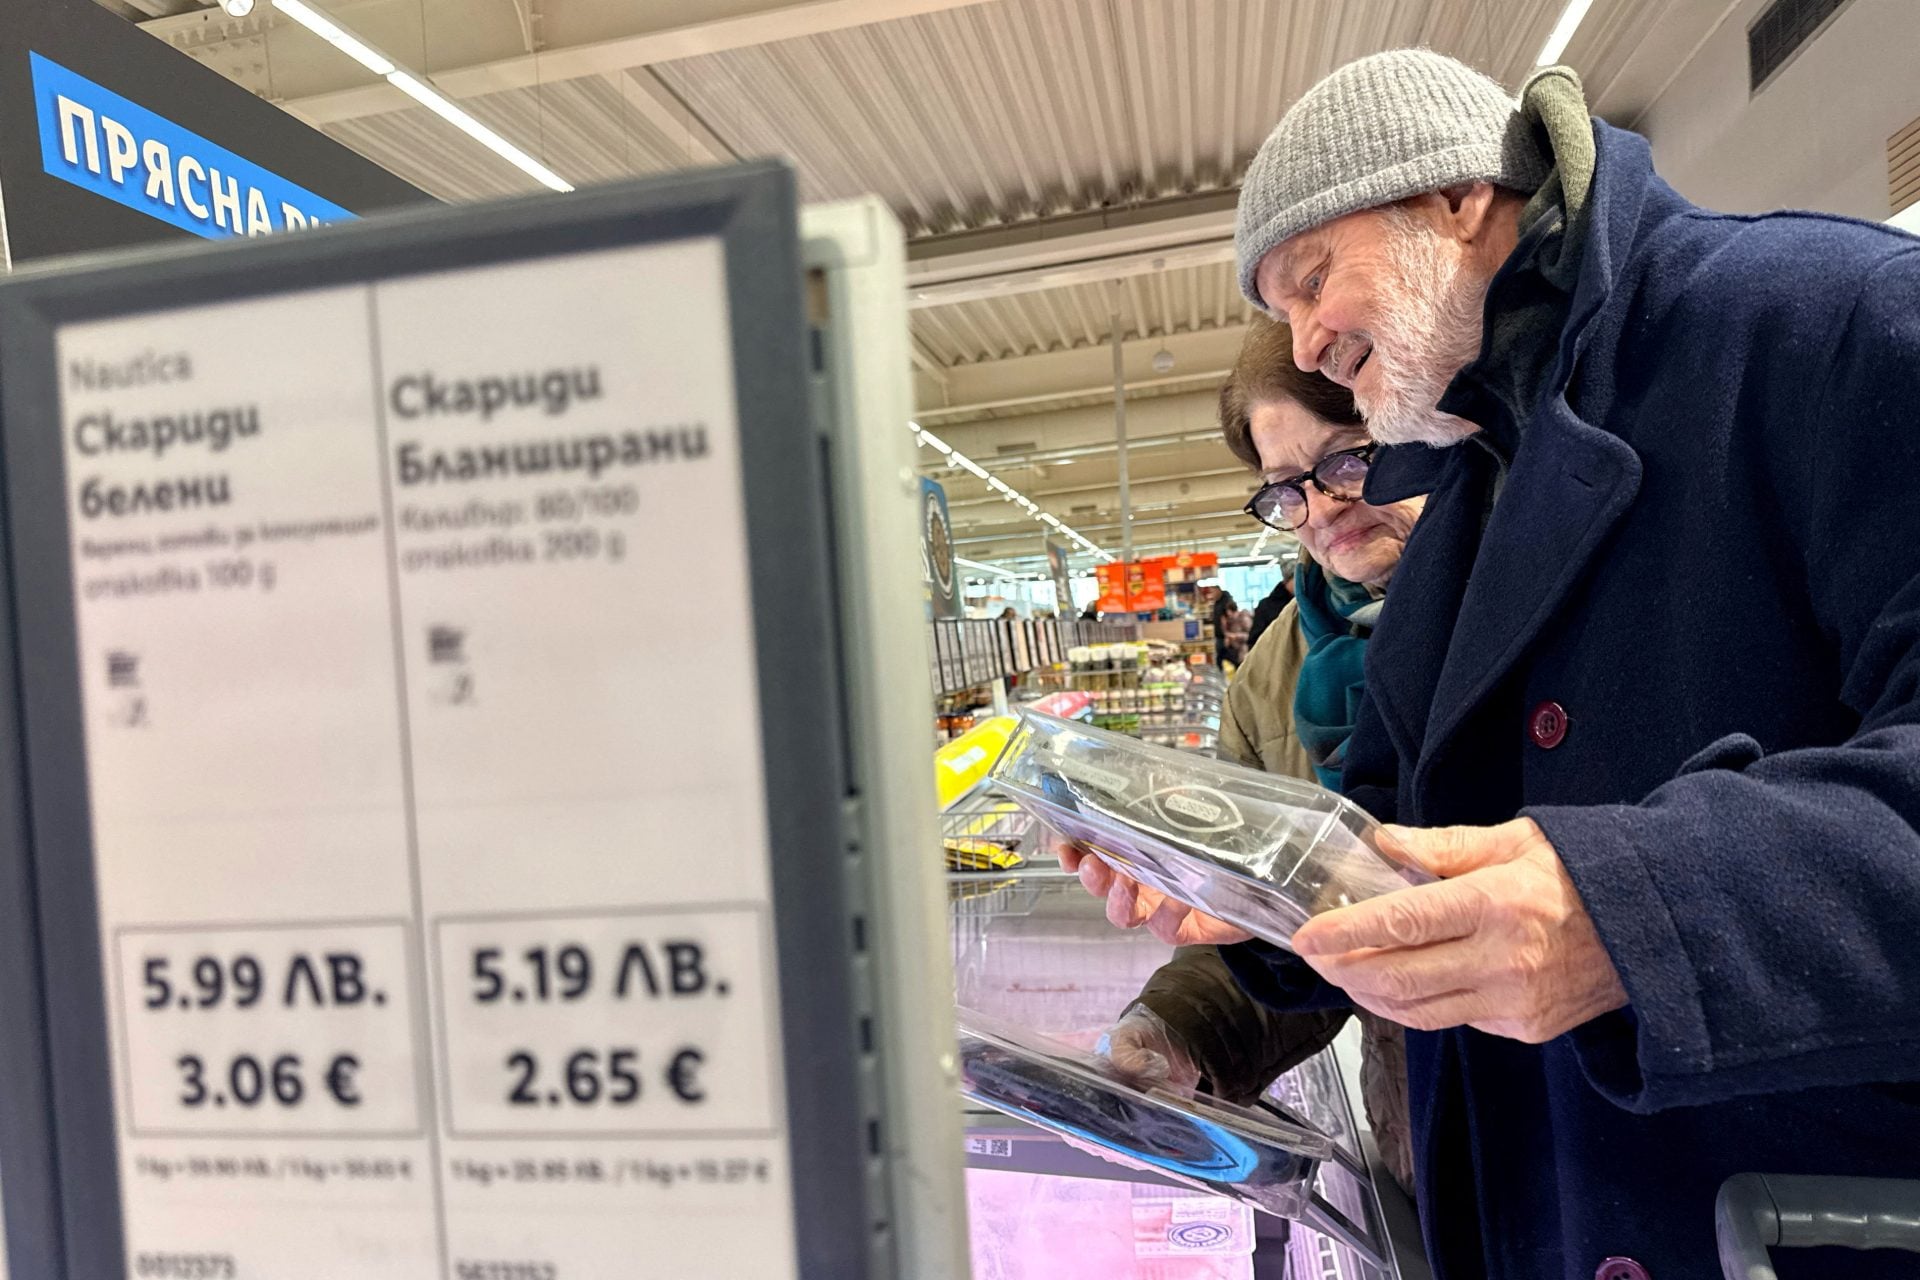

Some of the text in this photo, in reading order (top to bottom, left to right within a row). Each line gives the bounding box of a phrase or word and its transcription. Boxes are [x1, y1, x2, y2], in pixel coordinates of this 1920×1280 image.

[57, 94, 273, 238] ПРЯСНА
[68, 349, 194, 391] Nautica
[389, 363, 604, 422] Скариди
[72, 404, 262, 457] Скариди
[396, 420, 710, 486] Бланширани
[79, 474, 232, 519] белени
[535, 484, 640, 521] 80/100
[206, 558, 254, 588] 100
[543, 530, 601, 564] 200
[143, 951, 389, 1010] 5.99 ЛВ.
[472, 939, 733, 1005] 5.19 ЛВ.
[177, 1052, 361, 1108] 3.06 €
[505, 1045, 706, 1107] 2.65 €
